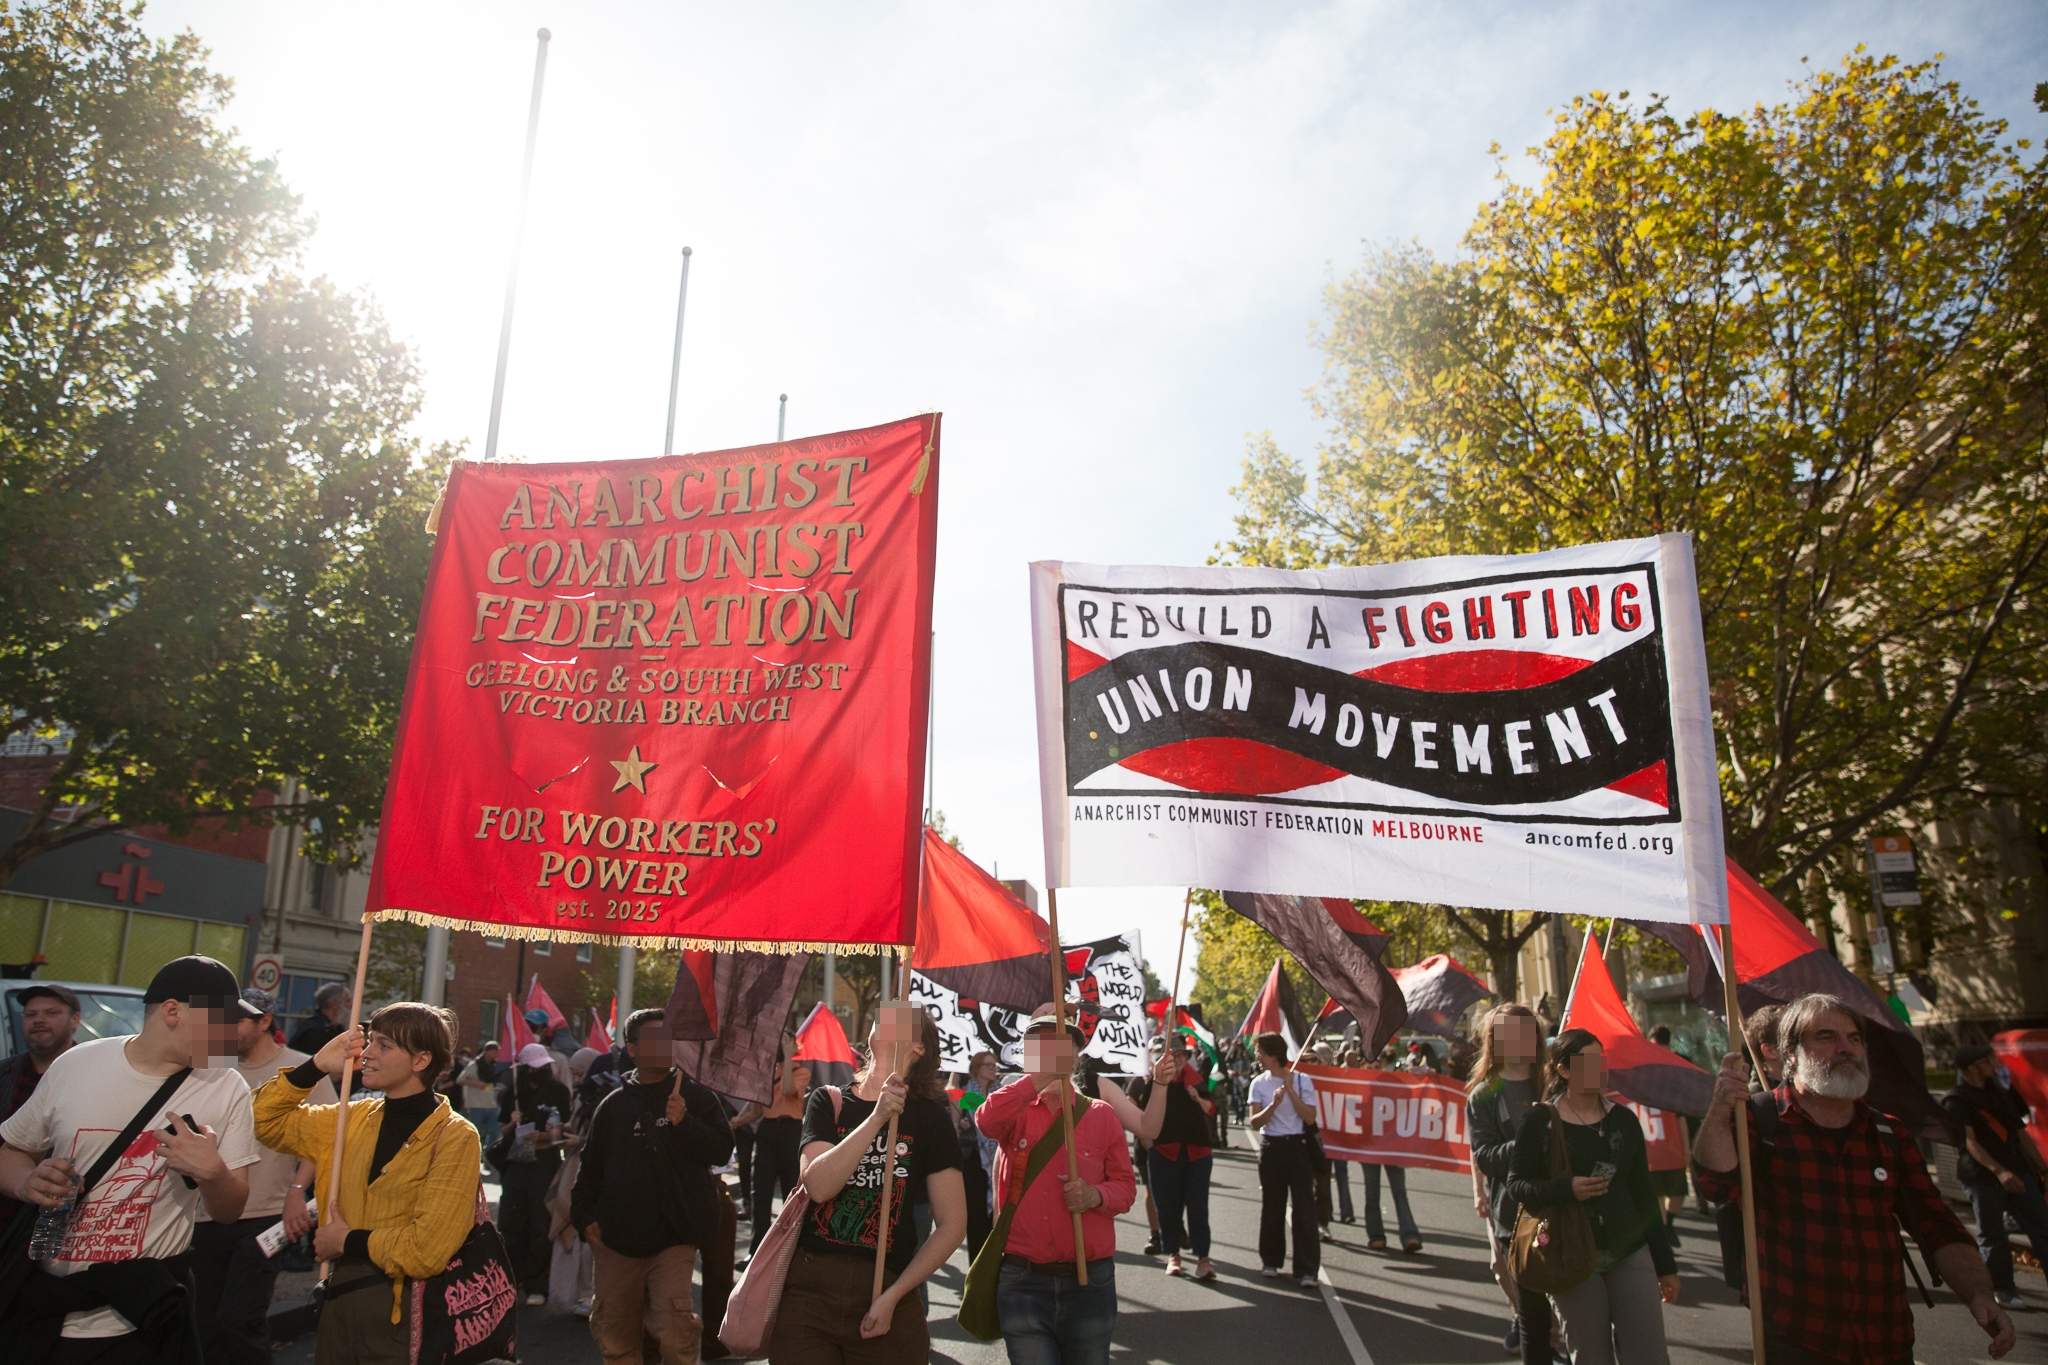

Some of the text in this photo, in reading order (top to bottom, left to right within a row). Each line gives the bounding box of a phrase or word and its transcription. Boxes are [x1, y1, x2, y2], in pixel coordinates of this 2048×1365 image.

[500, 457, 868, 531] ANARCHIST
[487, 522, 864, 588] COMMUNIST
[471, 588, 860, 649] FEDERATION
[1078, 582, 1642, 649] REBUILD A FIGHTING
[465, 661, 848, 695] GEELONG & SOUTH WEST
[499, 690, 793, 726] VICTORIA BRANCH
[1096, 666, 1628, 775] UNION MOVEMENT
[474, 805, 544, 843] FOR
[1075, 804, 1674, 855] ANARCHIST COMMUNIST FEDERATION MELBOURNE ancomfed.org
[536, 852, 689, 897] POWER
[555, 900, 661, 922] est. 2025
[257, 968, 276, 984] 40
[1098, 962, 1133, 980] THE
[1100, 981, 1142, 1002] WORLD
[1098, 1022, 1146, 1049] WIN!
